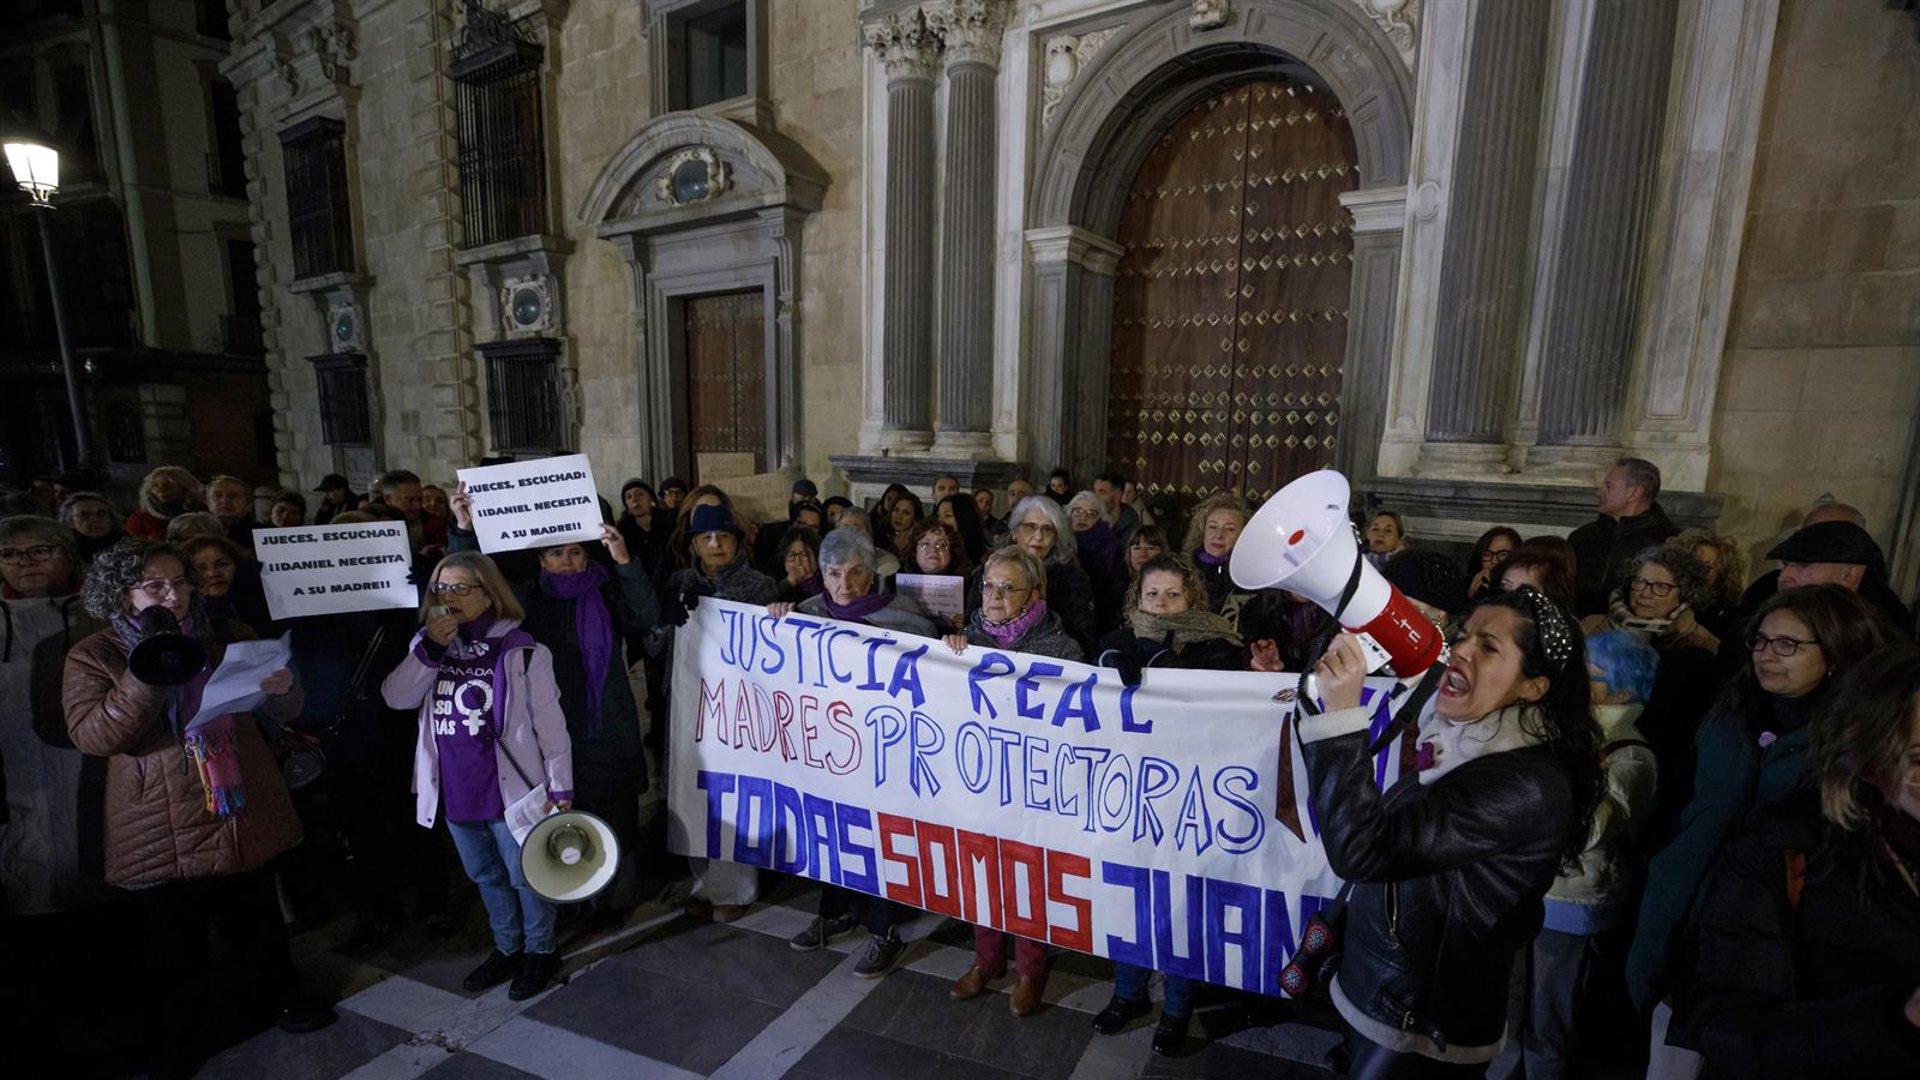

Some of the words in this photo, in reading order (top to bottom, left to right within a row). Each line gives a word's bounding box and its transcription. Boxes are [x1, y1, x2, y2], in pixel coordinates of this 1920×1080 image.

[468, 480, 515, 494] JUECES,
[518, 471, 586, 487] ESCUCHAD:
[534, 496, 591, 511] NECESITA
[261, 533, 319, 546] JUECES,
[322, 528, 401, 542] ESCUCHAD:
[501, 531, 509, 540] A
[512, 529, 527, 539] SU
[531, 522, 582, 536] MADRE!!
[338, 554, 405, 567] NECESITA
[293, 587, 304, 596] A
[307, 585, 326, 596] SU
[330, 580, 391, 594] MADRE!!
[967, 651, 1154, 734] REAL
[694, 677, 862, 775] MADRES
[864, 705, 1266, 855] PROTECTORAS
[697, 770, 881, 897] TODAS
[877, 812, 1094, 955] SOMOS
